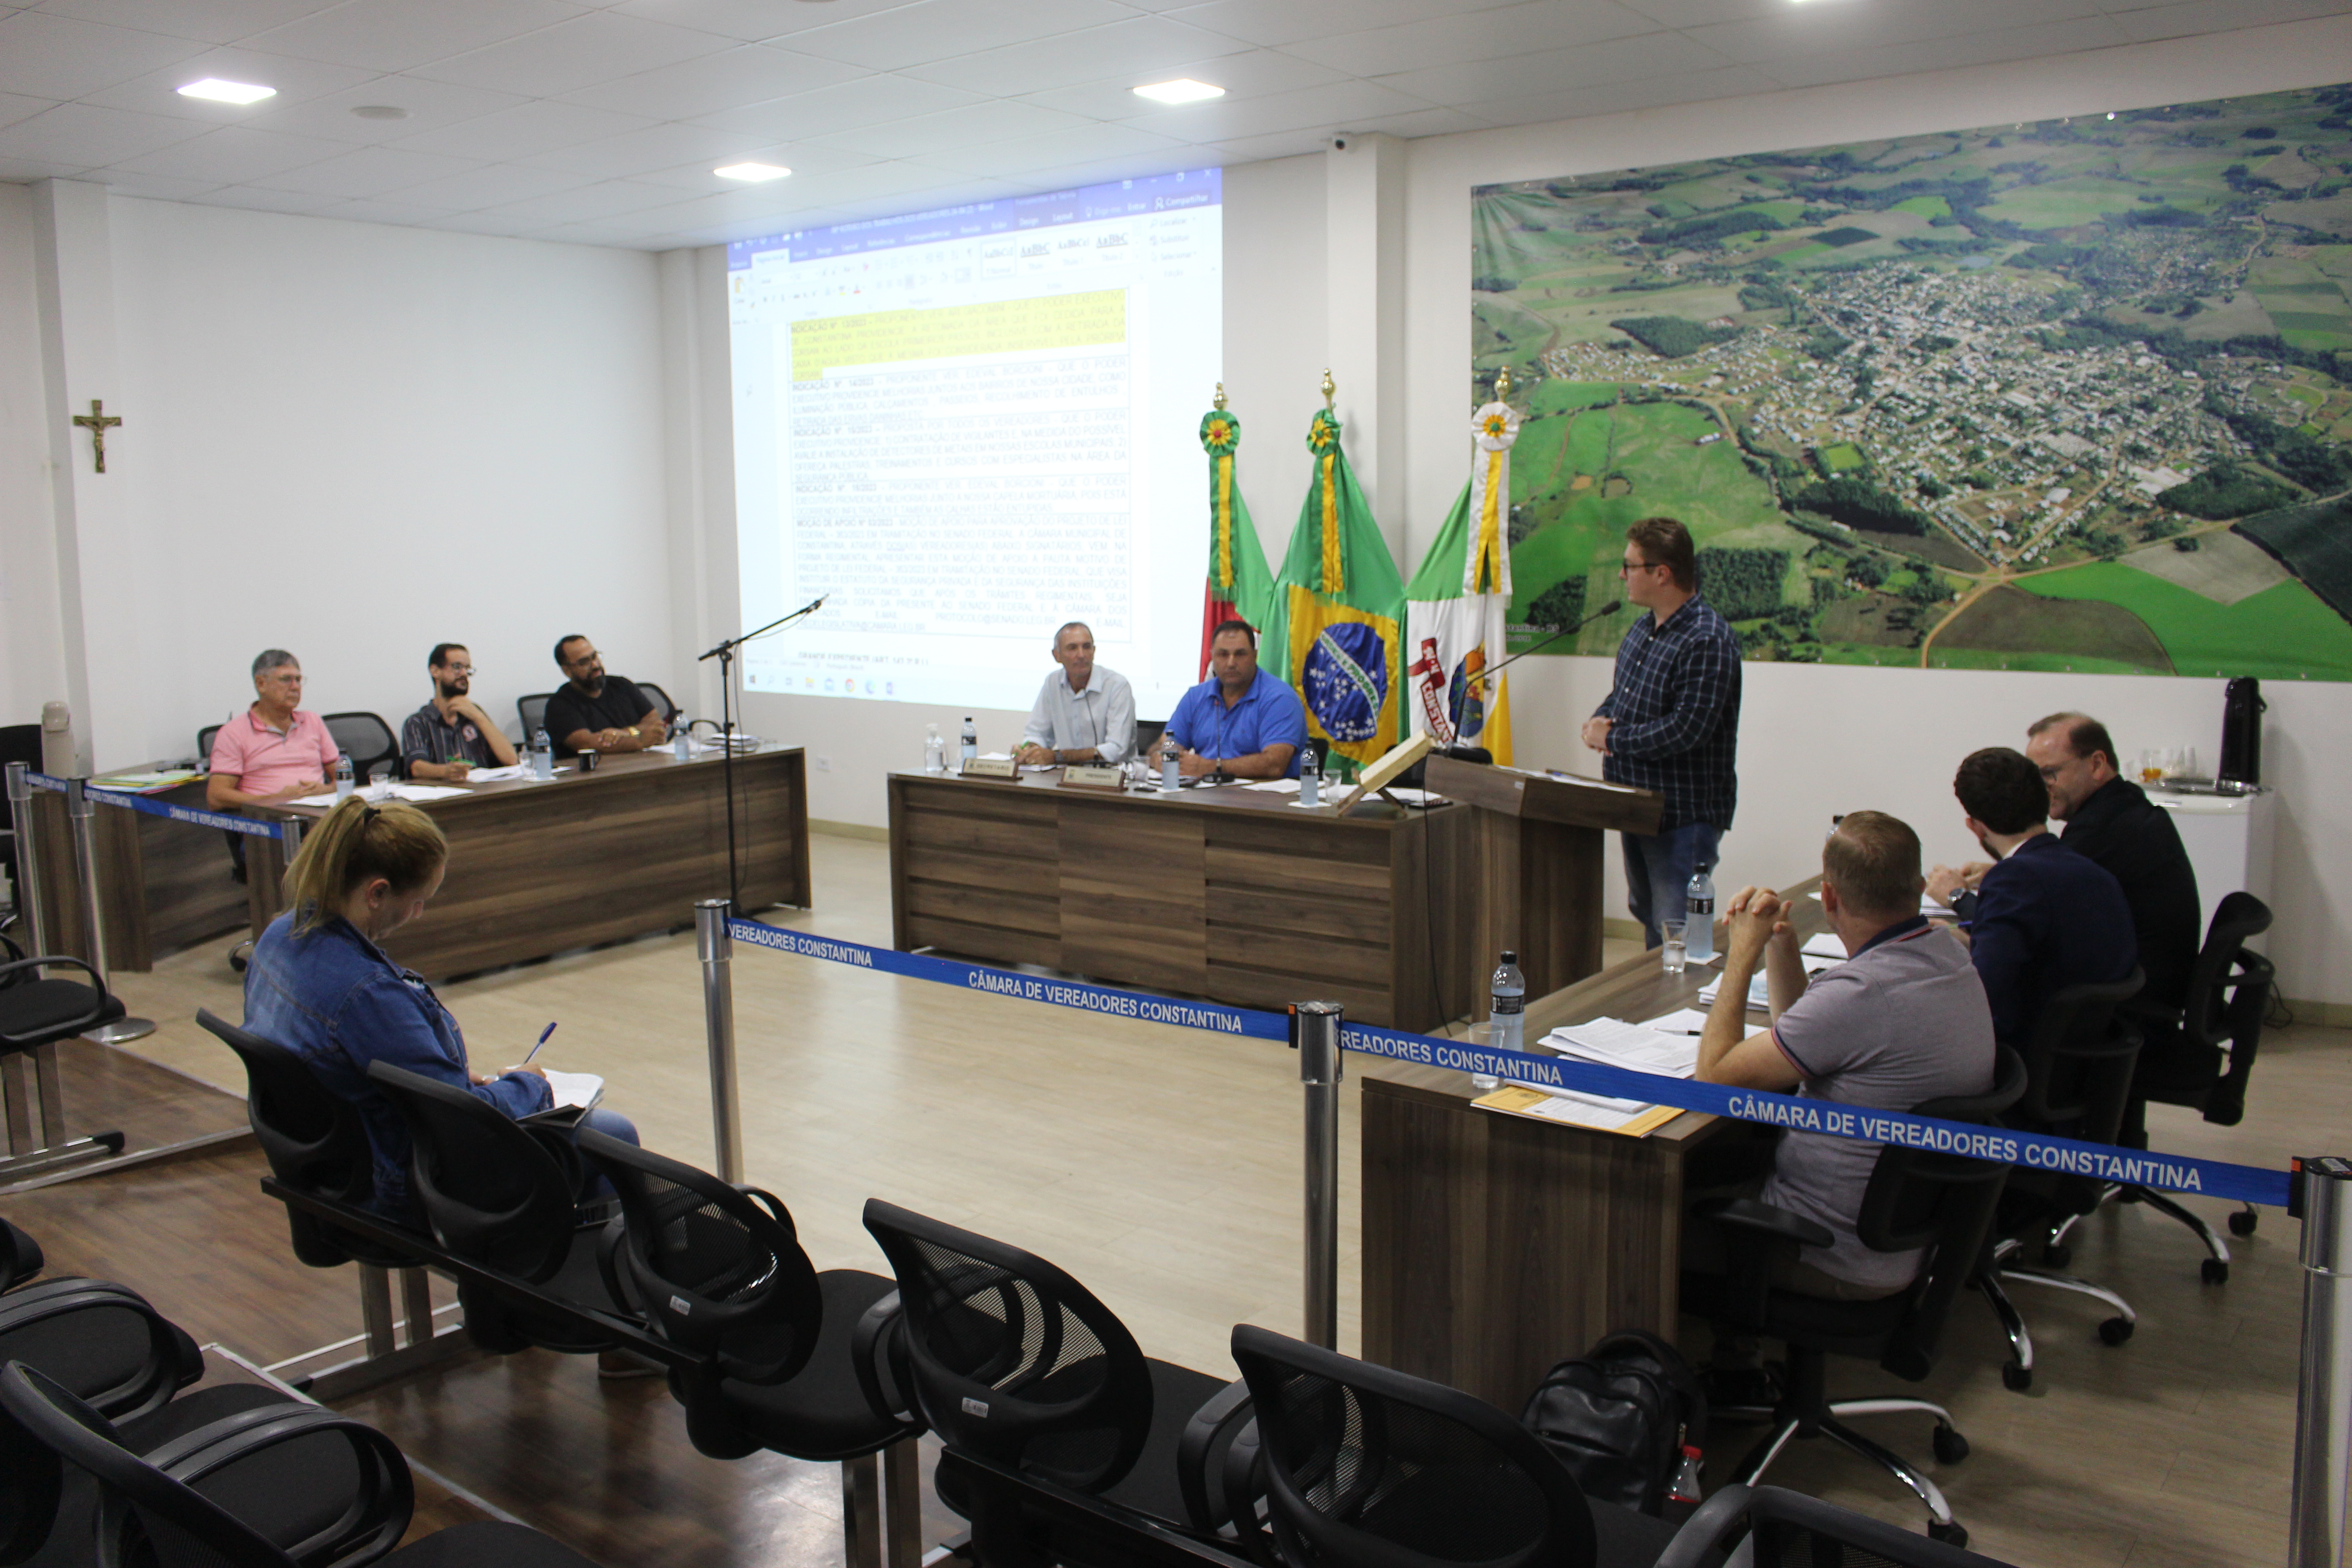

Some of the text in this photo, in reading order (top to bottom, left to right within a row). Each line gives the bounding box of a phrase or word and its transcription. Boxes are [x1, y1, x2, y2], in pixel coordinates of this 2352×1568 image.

[1347, 663, 1379, 718] PROGRESS
[728, 924, 872, 966] VEREADORES CONSTANTINA
[969, 970, 1242, 1034] CÂMARA DE VEREADORES CONSTANTINA
[1340, 1030, 1562, 1084] READORES CONSTANTINA
[1729, 1094, 2200, 1190] CÂMARA DE VEREADORES CONSTANTINA
